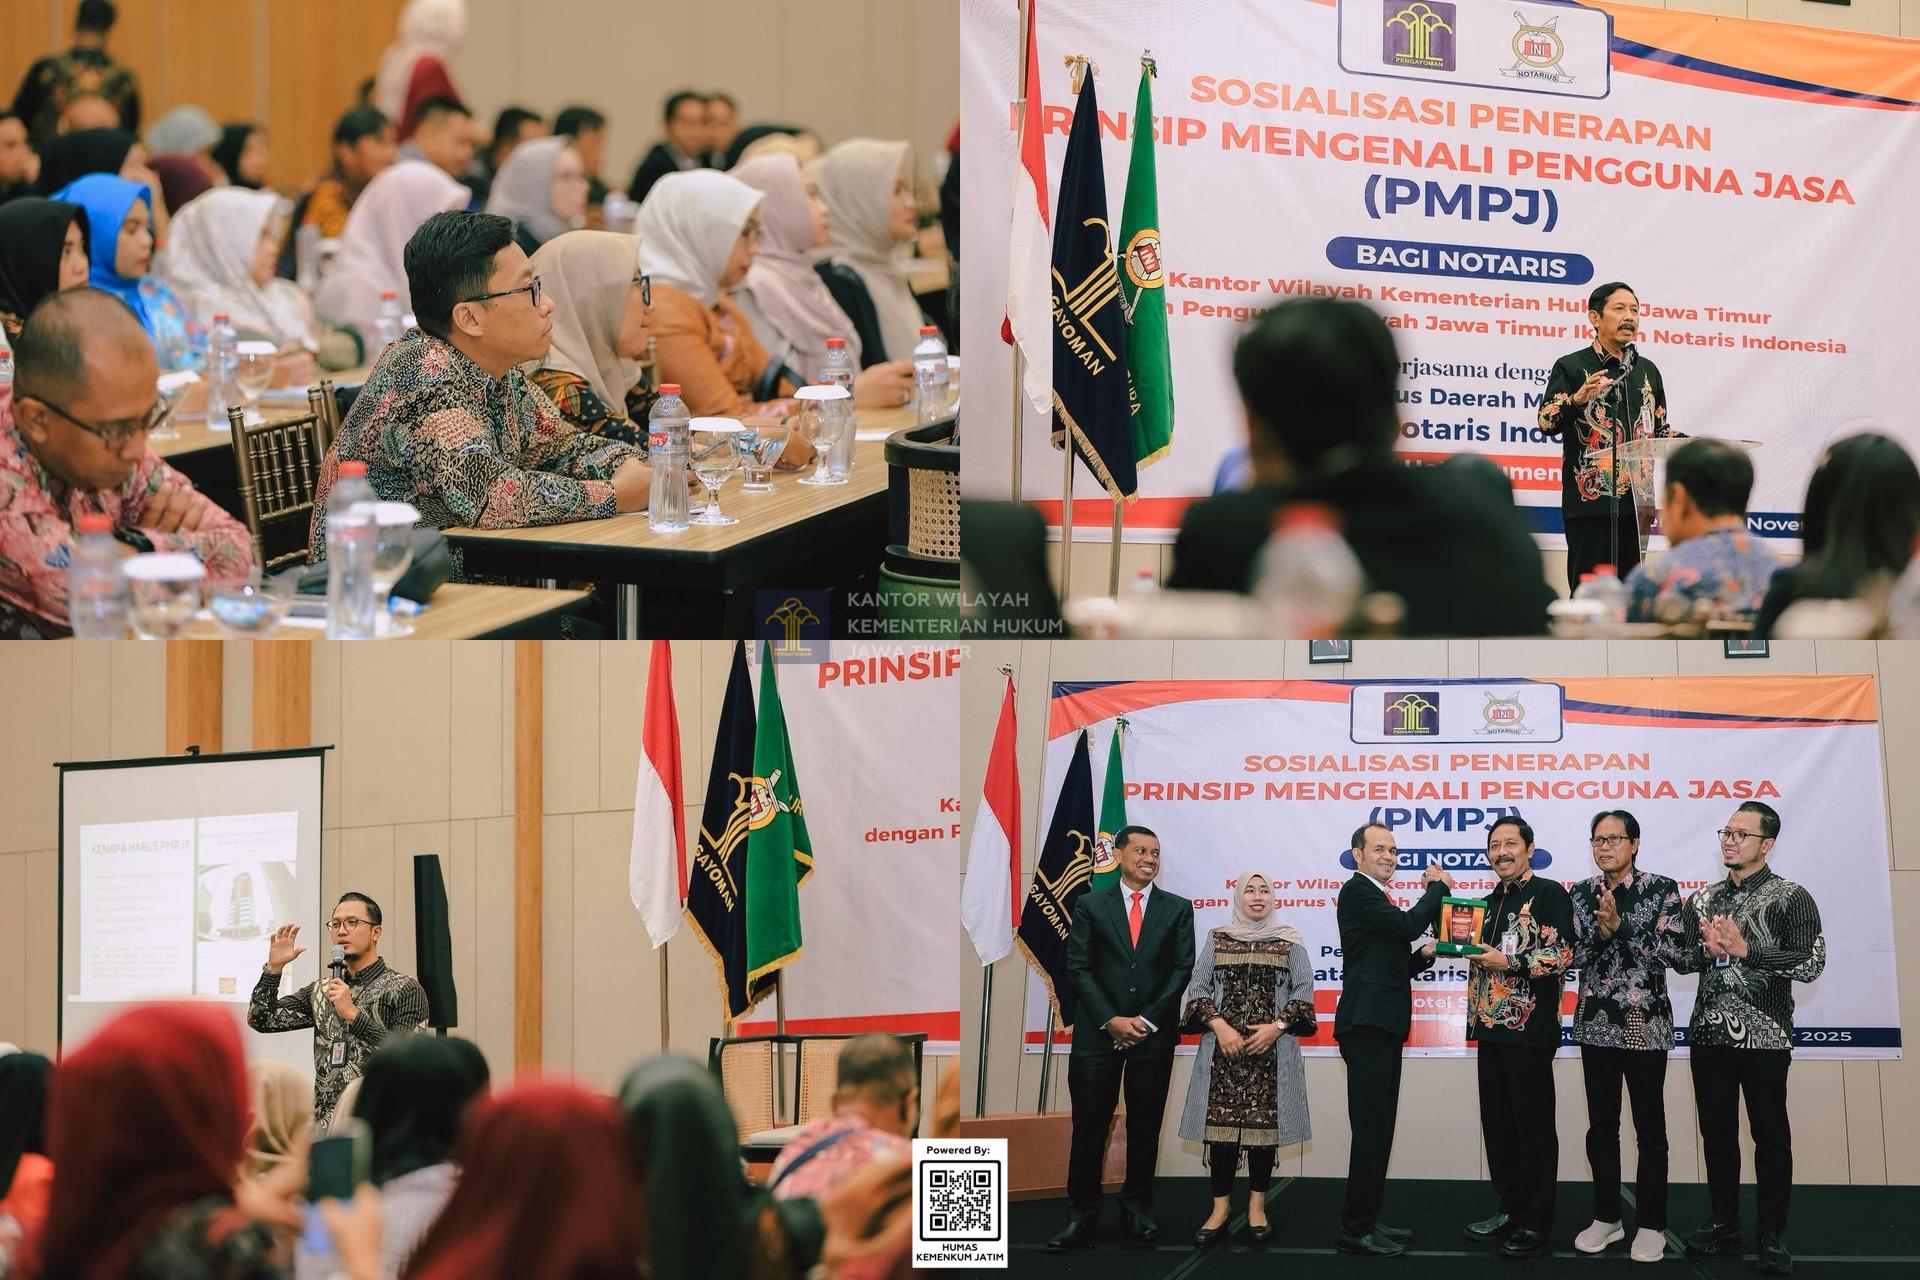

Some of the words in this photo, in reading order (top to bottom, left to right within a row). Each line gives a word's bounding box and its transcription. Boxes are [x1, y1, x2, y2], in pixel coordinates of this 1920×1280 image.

[1395, 56, 1444, 68] PENGAYOMAN
[1517, 71, 1558, 82] NOTARIUS
[1190, 74, 1456, 127] SOSIALISASI
[1469, 103, 1711, 152] PENERAPAN
[1009, 102, 1207, 147] RNIP
[1221, 122, 1493, 175] MENGENALI
[1508, 148, 1743, 196] PENGGUNA
[1754, 171, 1856, 206] JASA
[1364, 173, 1559, 233] (PMPJ)
[1356, 243, 1430, 269] BAGI
[1439, 249, 1567, 278] NOTARIS
[1169, 271, 1260, 293] Kantor
[1267, 277, 1373, 301] Wilayah
[1381, 286, 1540, 311] Kementerian
[1548, 297, 1589, 313] Huk
[1639, 303, 1698, 321] Jawa
[1704, 307, 1772, 325] Timur
[1051, 295, 1105, 376] GAYOMAN
[1426, 315, 1489, 334] Jawa
[1496, 320, 1567, 338] Timur
[1653, 329, 1735, 348] Notaris
[1742, 334, 1847, 354] Indonesia
[1401, 357, 1488, 380] rjasama
[1430, 388, 1515, 409] Daerah
[1401, 417, 1491, 442] otaris
[1747, 517, 1800, 532] Nove
[1244, 753, 1440, 772] SOSIALISASI
[1450, 753, 1650, 771] PENERAPAN
[1124, 782, 1255, 801] PRINSIP
[1265, 781, 1469, 801] MENGENALI
[1480, 780, 1679, 800] PENGGUNA
[1688, 779, 1781, 799] JASA
[864, 826, 944, 844] dengan
[91, 842, 127, 855] KENAPA
[128, 841, 159, 853] HARUS
[1426, 853, 1491, 867] NOTA
[694, 843, 736, 913] GAYOMAN
[1029, 883, 1070, 942] GAYOMAN
[1413, 996, 1451, 1008] otel
[1801, 1031, 1852, 1042] 2025
